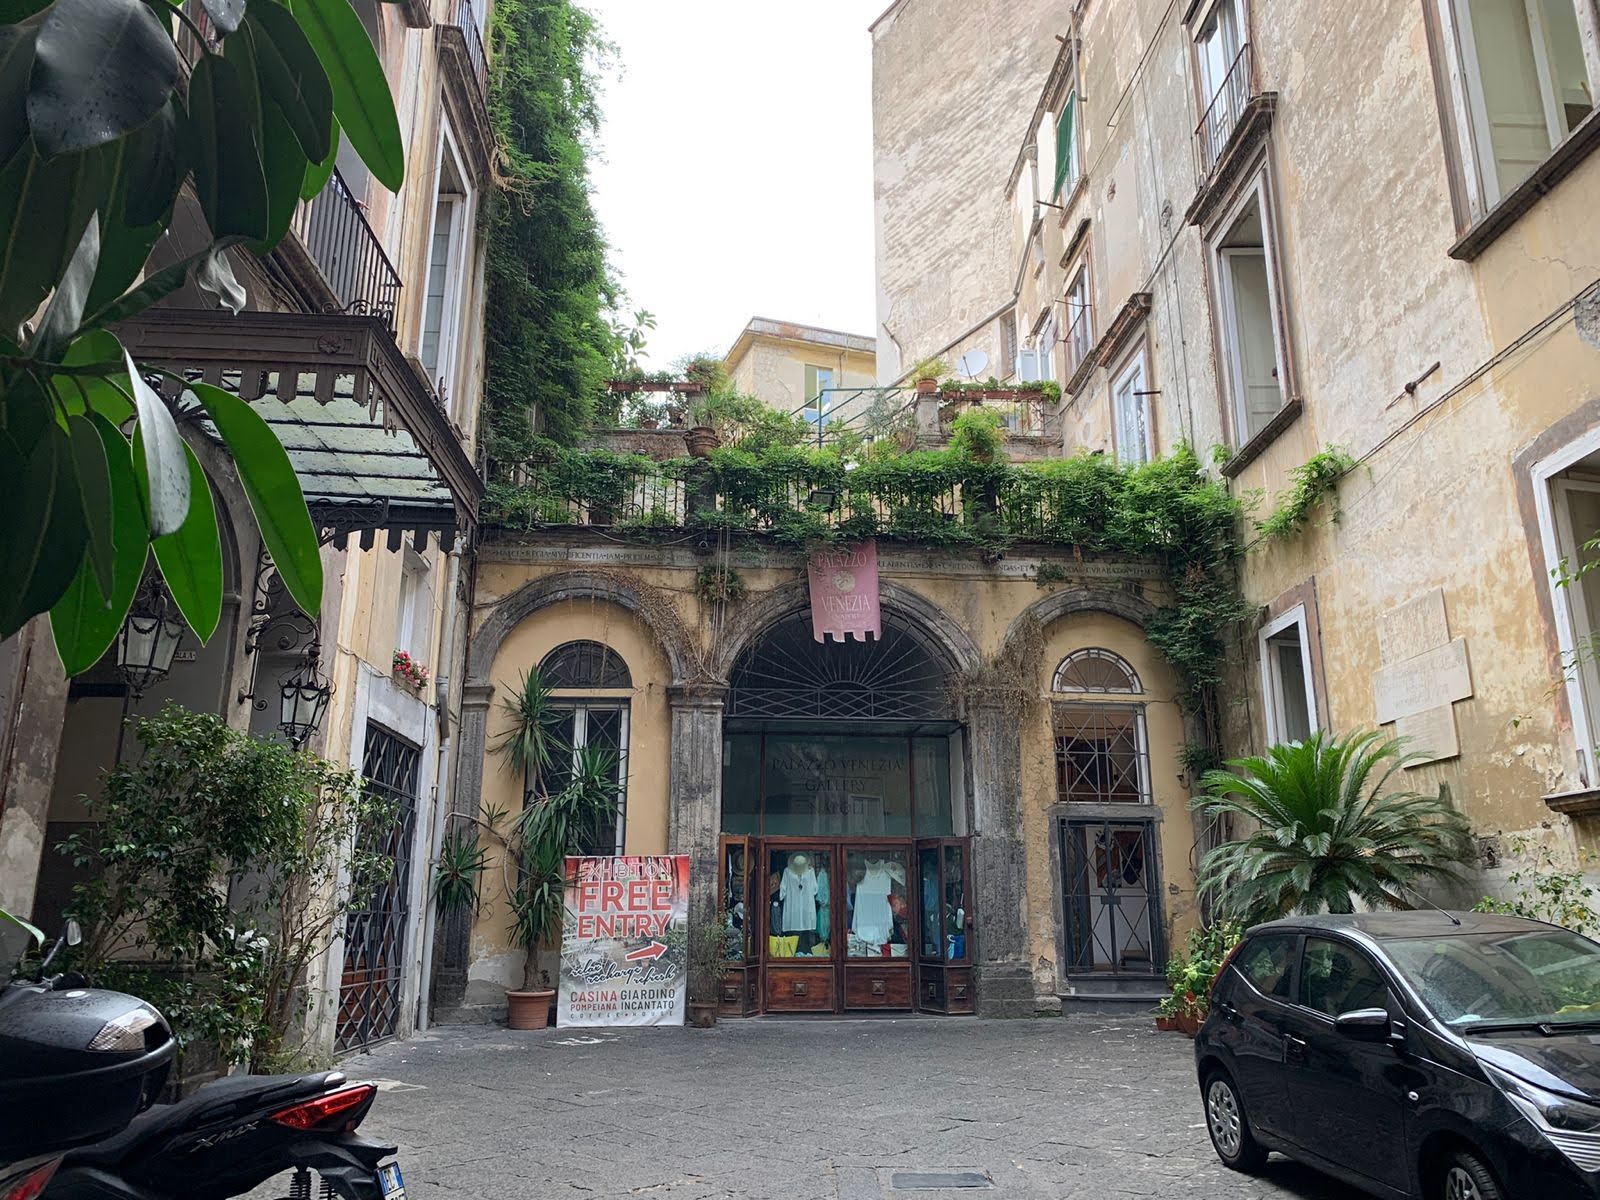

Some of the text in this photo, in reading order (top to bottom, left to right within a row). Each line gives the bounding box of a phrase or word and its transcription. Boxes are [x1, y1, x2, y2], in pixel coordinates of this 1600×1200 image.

[818, 551, 867, 567] PALAZZO
[821, 594, 871, 611] VENEZIA
[842, 759, 902, 771] VENEZIA
[805, 779, 865, 792] GALLERY
[580, 863, 671, 880] EXHIBITION
[578, 880, 672, 913] FREE
[577, 913, 671, 940] ENTRY
[570, 959, 603, 977] relax
[585, 962, 643, 985] recharge
[632, 963, 676, 985] refresh
[570, 988, 676, 1003] CASINA GIARDINO
[570, 1001, 675, 1012] POMPEIANA INCANTATO
